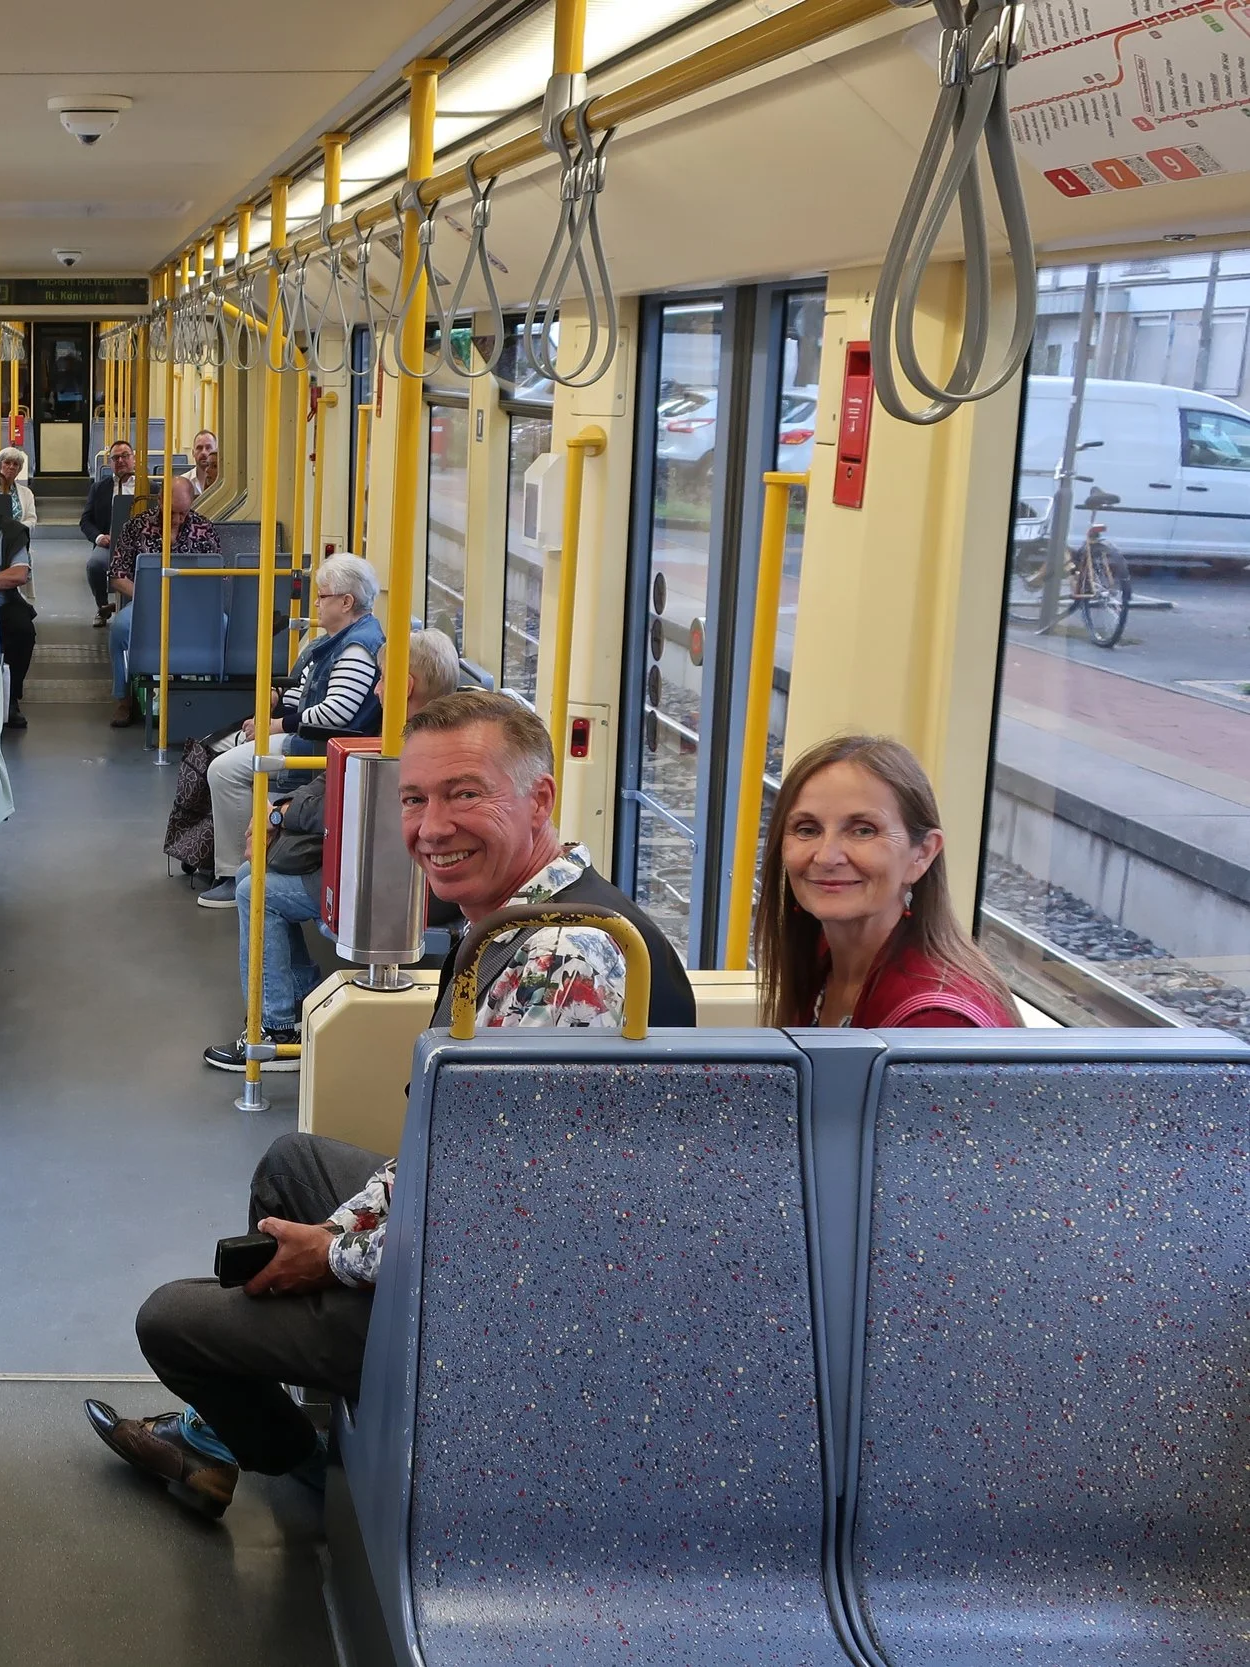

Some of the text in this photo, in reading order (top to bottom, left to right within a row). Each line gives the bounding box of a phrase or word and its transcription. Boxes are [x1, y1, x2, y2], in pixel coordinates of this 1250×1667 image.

[1161, 155, 1184, 173] 9
[1056, 173, 1076, 191] 1
[1105, 165, 1124, 183] 7
